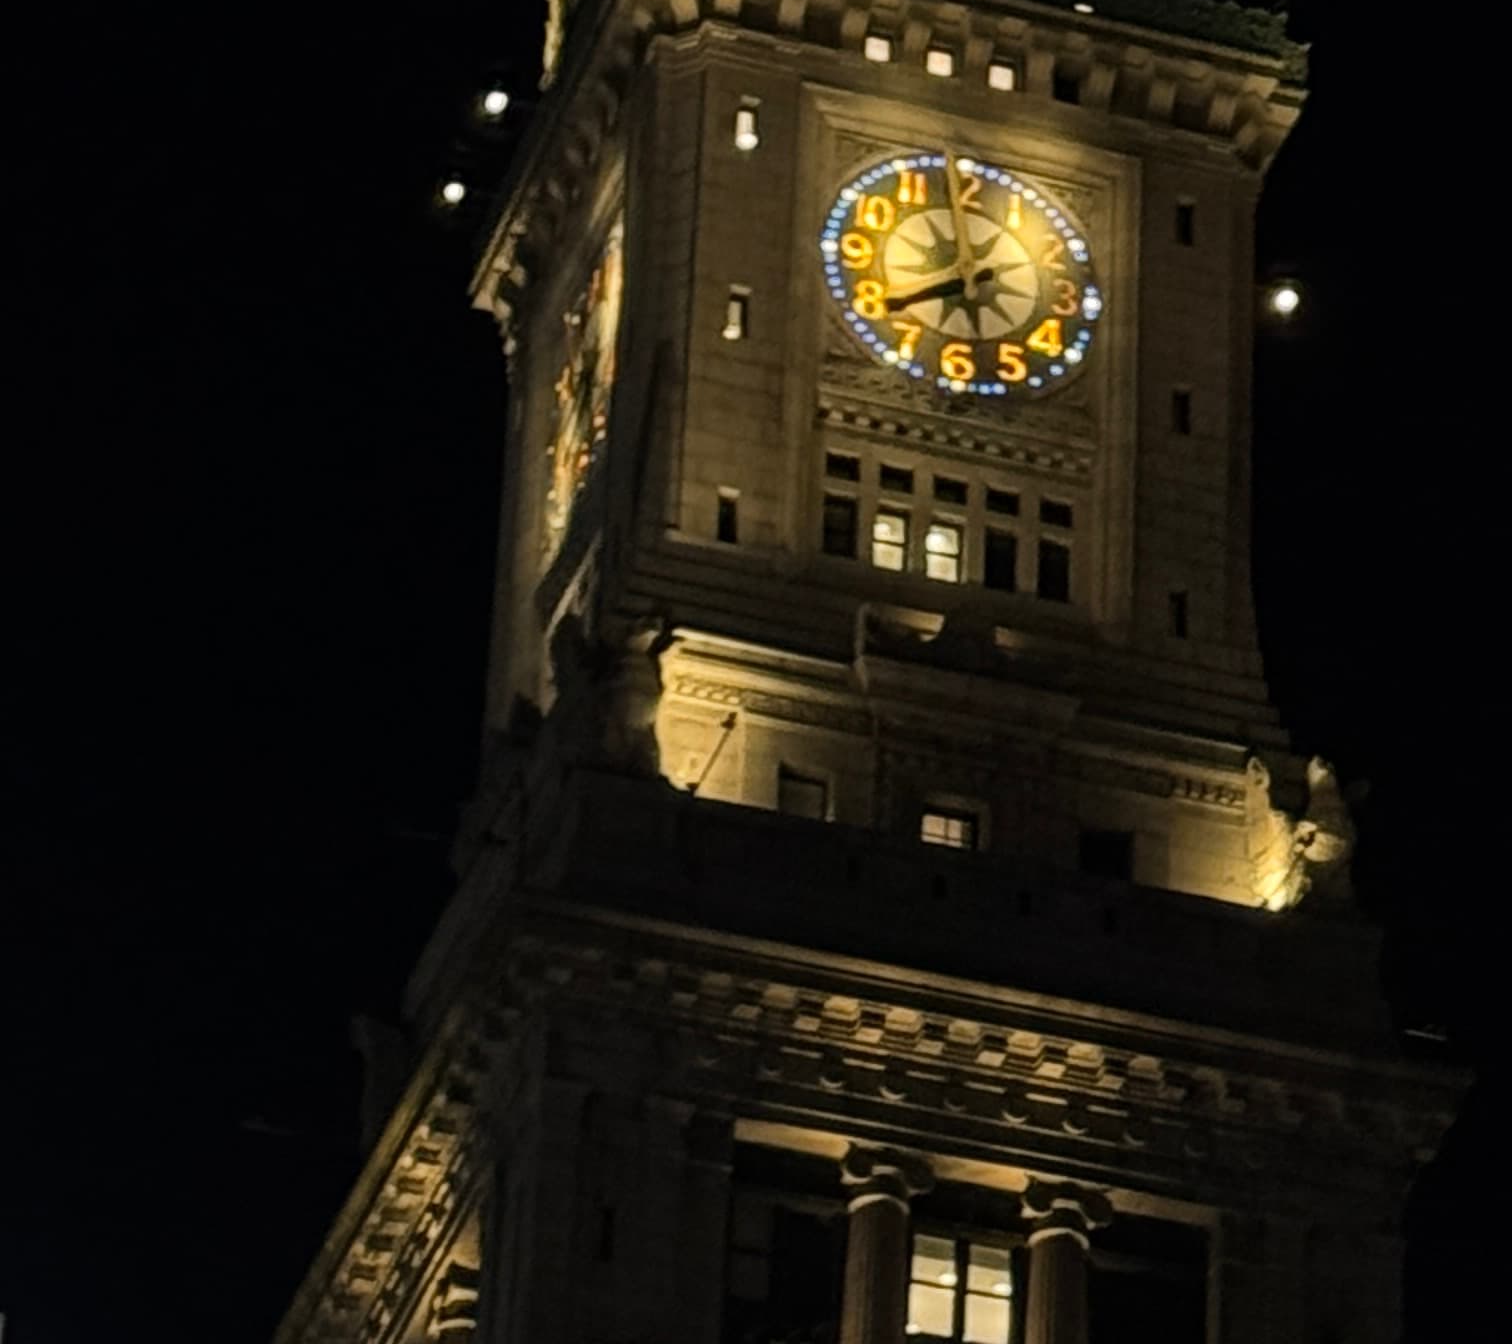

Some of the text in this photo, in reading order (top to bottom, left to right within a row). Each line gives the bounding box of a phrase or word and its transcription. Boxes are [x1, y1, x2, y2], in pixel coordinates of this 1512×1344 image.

[841, 232, 873, 270] 9
[1041, 233, 1067, 270] 2
[852, 280, 886, 320] 8
[1052, 279, 1078, 316] 3
[892, 321, 922, 360] 7
[1026, 319, 1063, 358] 4
[940, 343, 975, 381] 6
[996, 343, 1028, 382] 5
